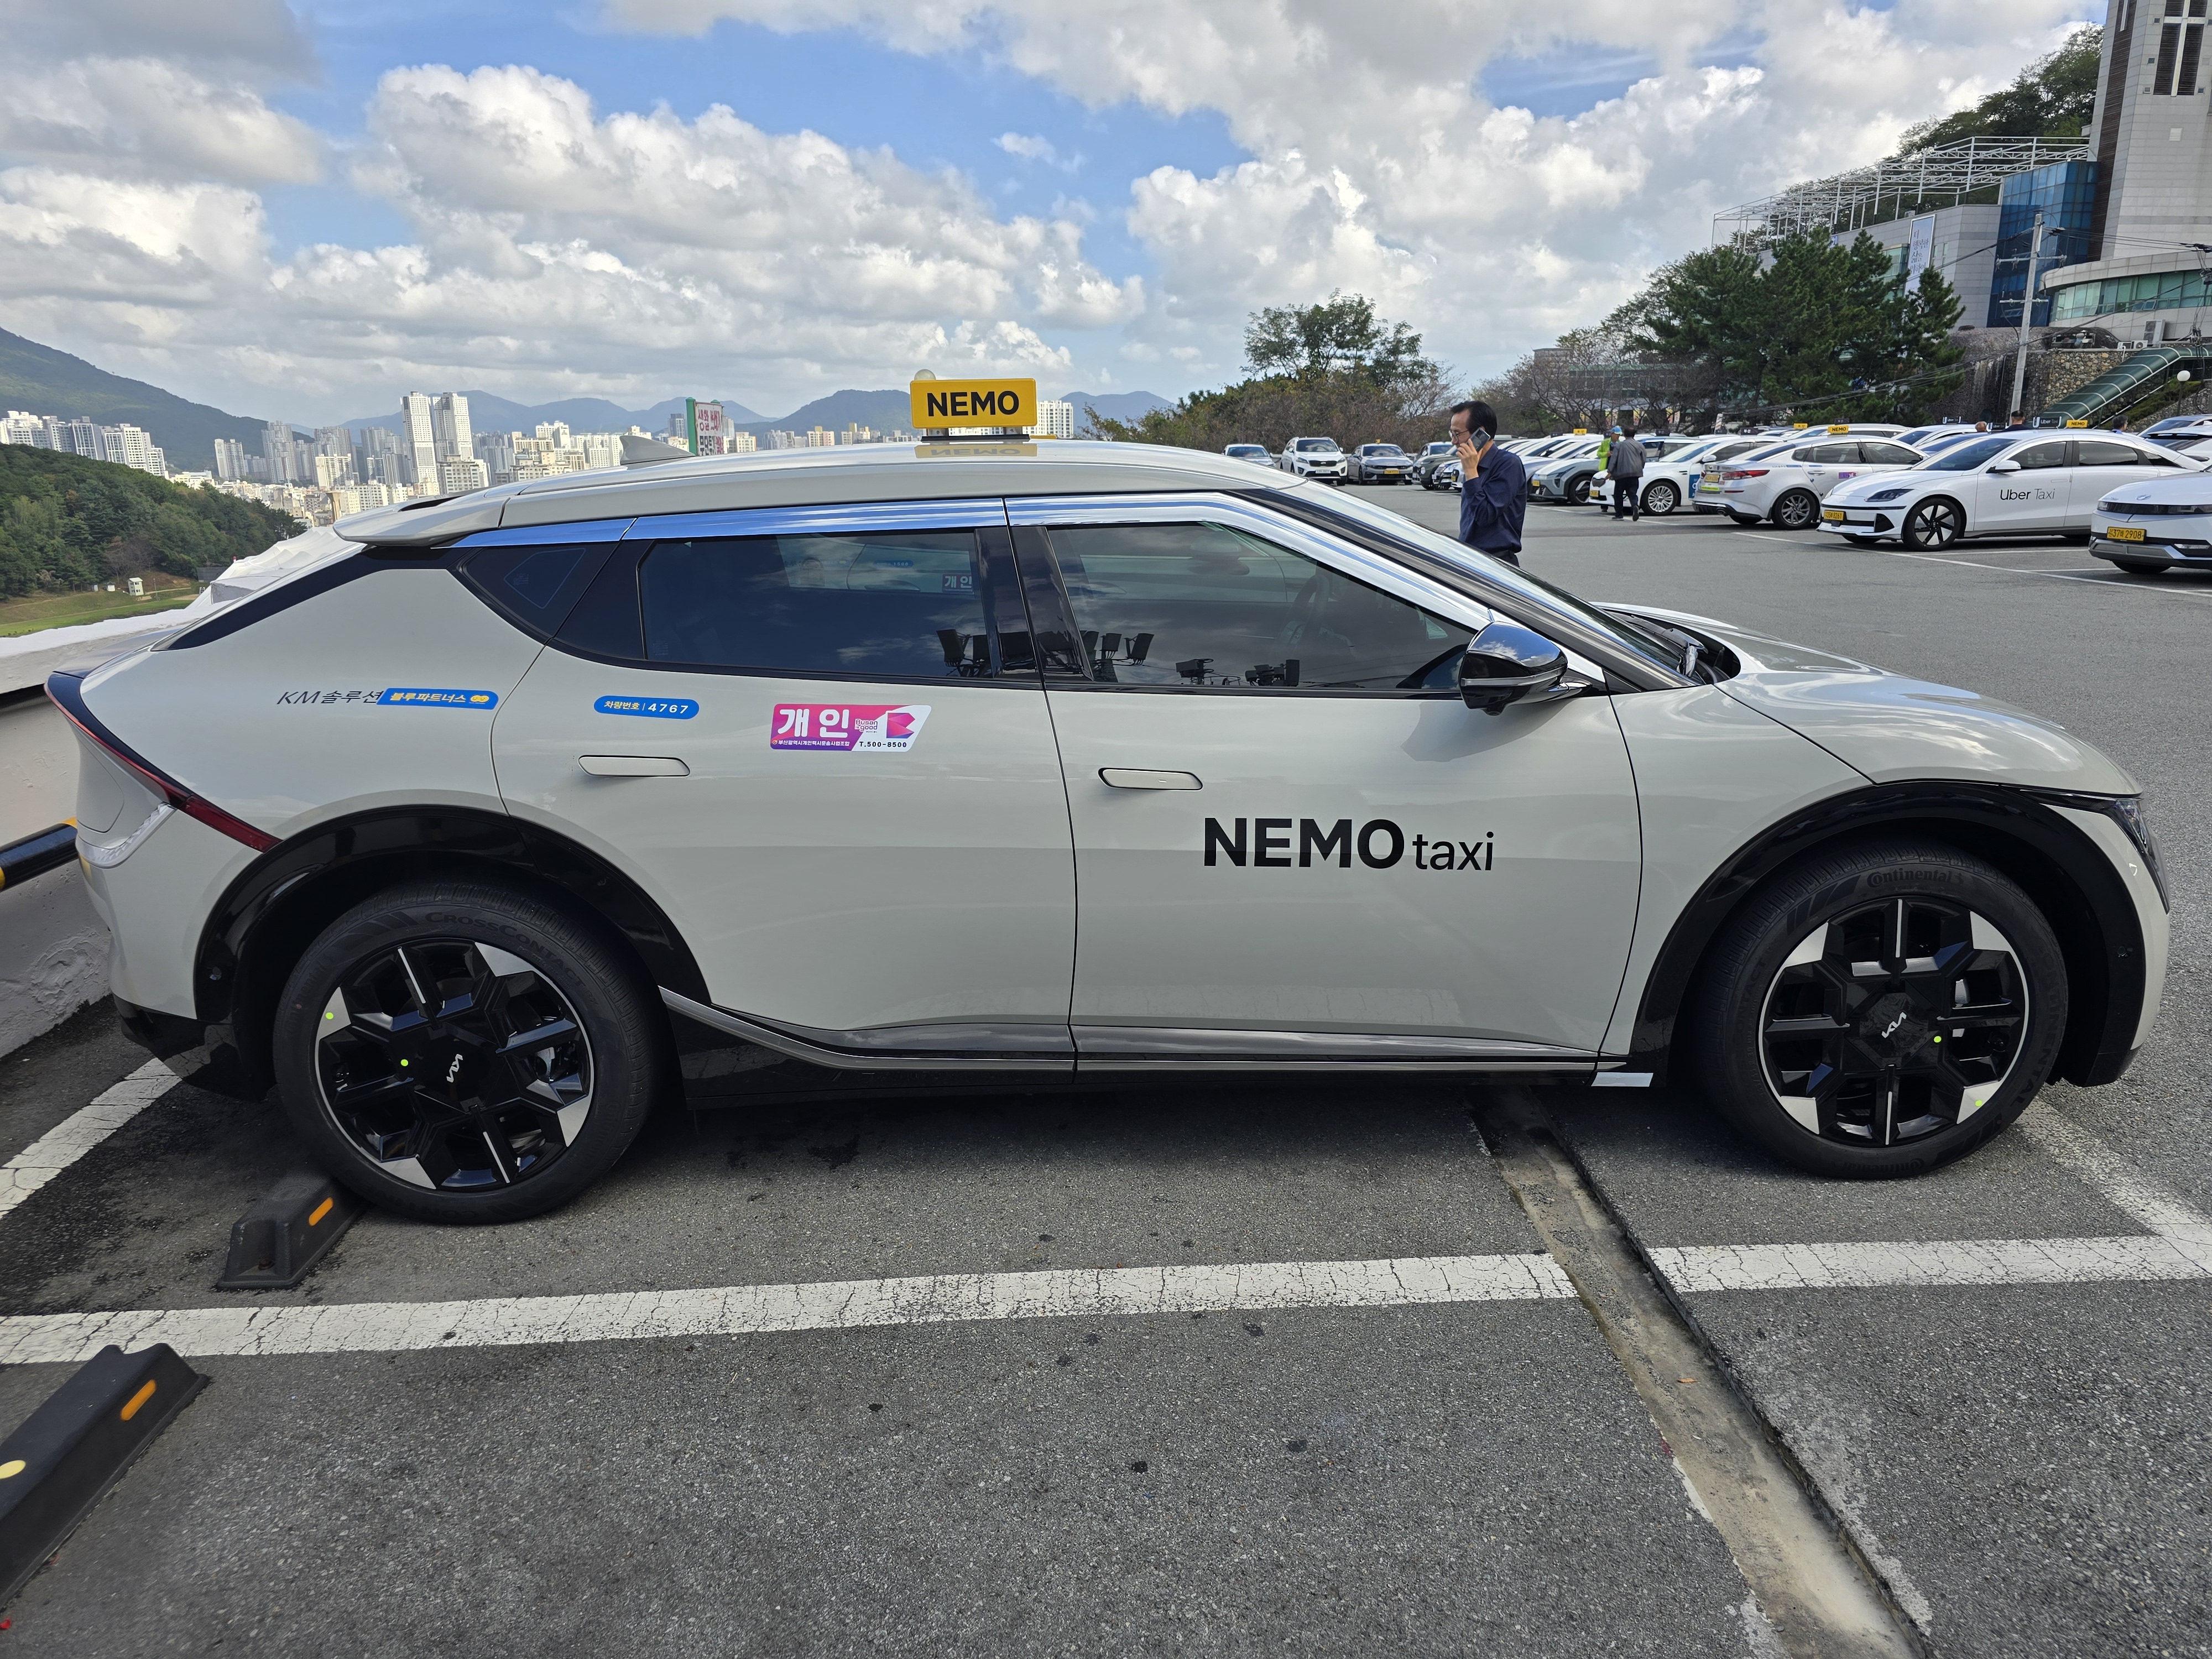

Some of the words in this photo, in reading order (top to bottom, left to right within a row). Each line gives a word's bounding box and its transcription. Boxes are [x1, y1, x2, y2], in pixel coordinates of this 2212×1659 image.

[1913, 238, 1929, 250] 행복한
[927, 390, 1019, 416] NEMO
[2000, 489, 2031, 500] Uber
[2034, 488, 2056, 499] Taxi
[2125, 530, 2142, 539] 2908
[276, 690, 385, 705] KM솔루션
[604, 701, 640, 710] 차량번호
[648, 703, 688, 714] 4767
[1204, 818, 1405, 869] NEMO
[1412, 831, 1494, 871] taxi
[1866, 868, 1952, 888] Continental
